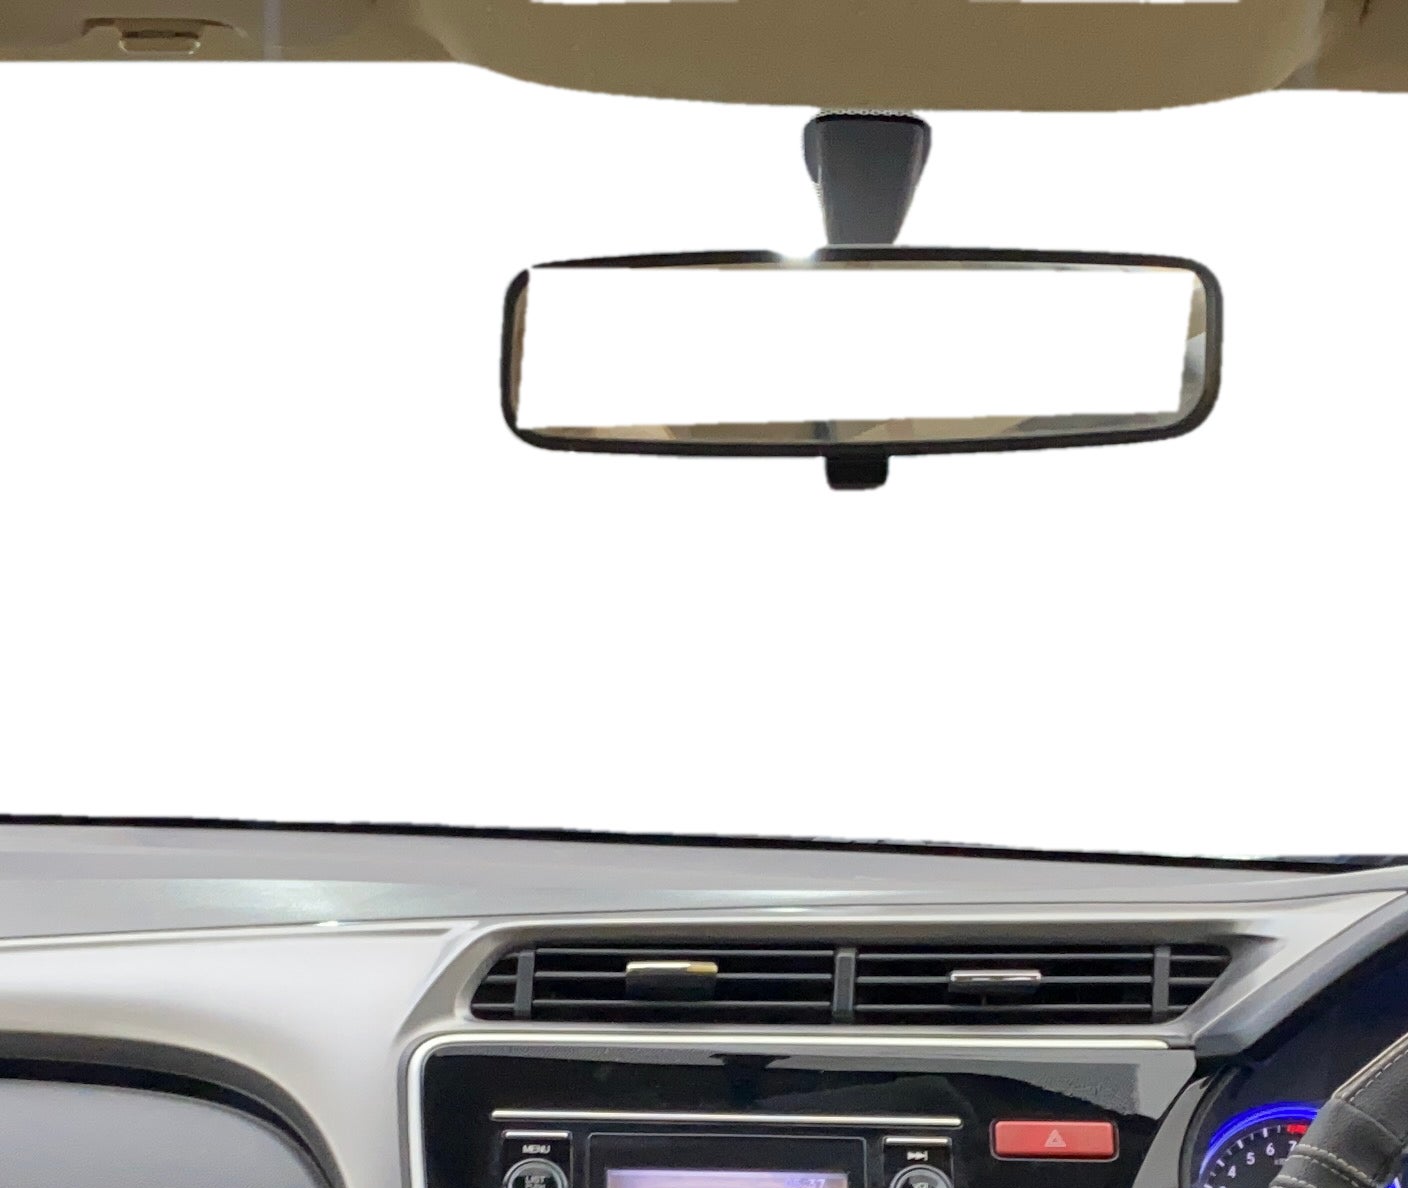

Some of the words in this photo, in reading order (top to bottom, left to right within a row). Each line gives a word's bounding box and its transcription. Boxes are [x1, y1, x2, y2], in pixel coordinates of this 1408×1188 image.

[522, 1144, 551, 1154] MENU
[1265, 1142, 1275, 1156] 6
[1246, 1152, 1255, 1165] 5
[1227, 1165, 1237, 1178] 4
